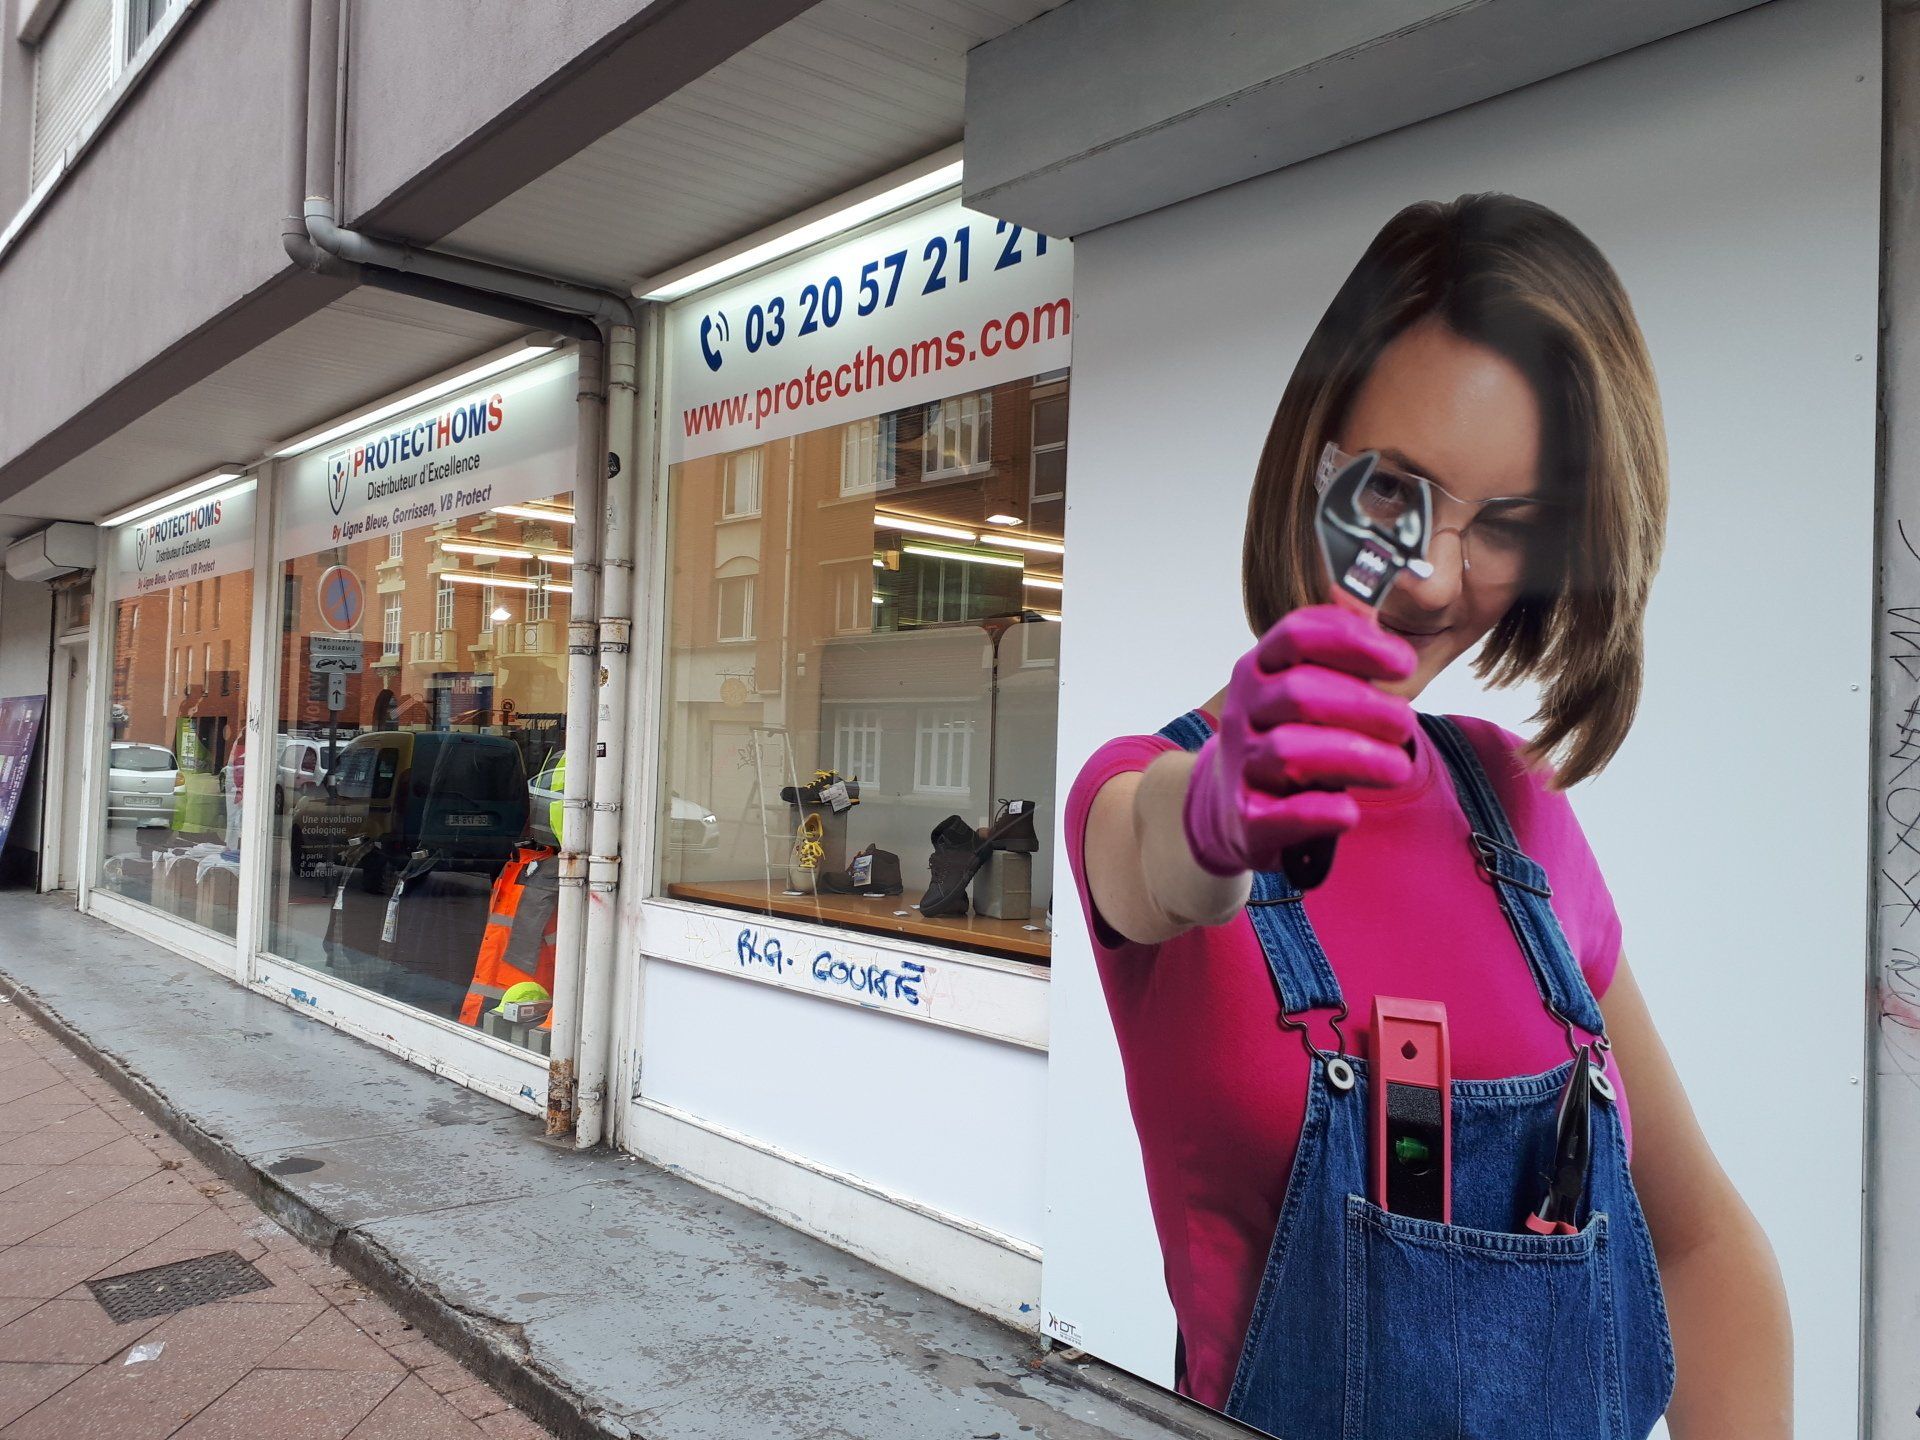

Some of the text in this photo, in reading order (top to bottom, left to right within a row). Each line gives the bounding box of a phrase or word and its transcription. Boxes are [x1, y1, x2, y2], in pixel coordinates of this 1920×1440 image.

[745, 296, 785, 353] 03
[798, 276, 843, 337] 20
[858, 249, 908, 316] 57
[921, 225, 970, 296] 21
[683, 298, 1071, 437] www.protecthoms.com
[353, 393, 503, 478] PROTECTHOMS
[367, 454, 480, 500] Distributeur d'Excellence
[149, 499, 222, 545] PROTECTHOMS
[332, 484, 492, 543] By Ligne Bleue, Gorrissen, VB Protect
[155, 546, 181, 563] Distributeur
[198, 560, 216, 574] Protect
[301, 826, 347, 836] écologique
[302, 815, 318, 824] Une
